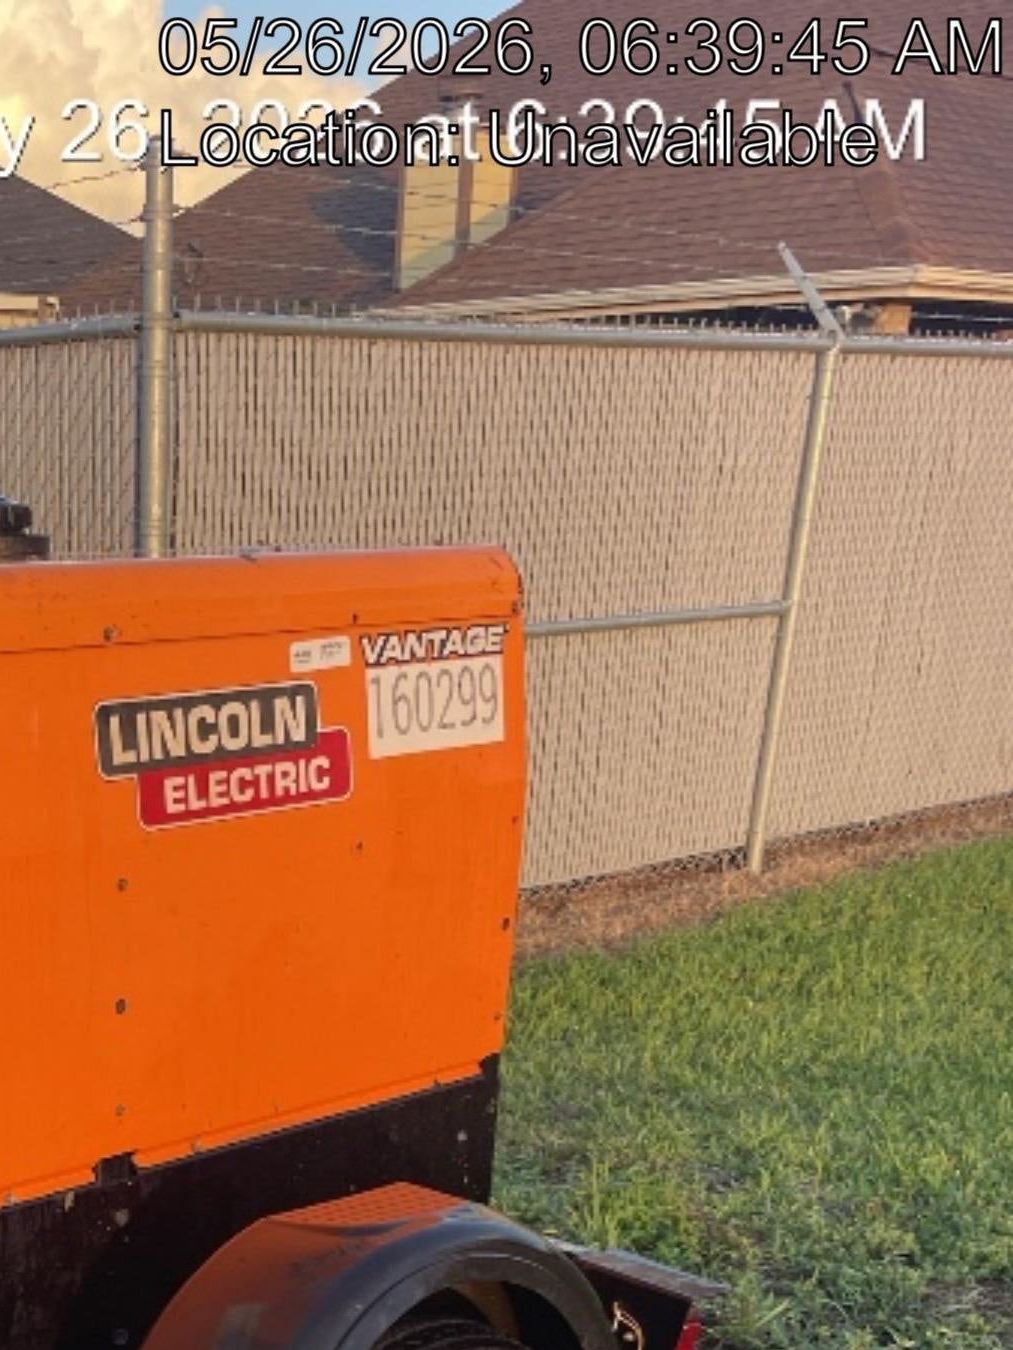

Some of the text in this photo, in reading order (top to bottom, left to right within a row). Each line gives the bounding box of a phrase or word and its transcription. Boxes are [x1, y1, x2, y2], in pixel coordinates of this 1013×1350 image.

[360, 624, 506, 667] VANTAGE
[108, 694, 307, 767] LINCOLN
[370, 662, 500, 739] 160299
[162, 755, 332, 816] ELECTRIC
